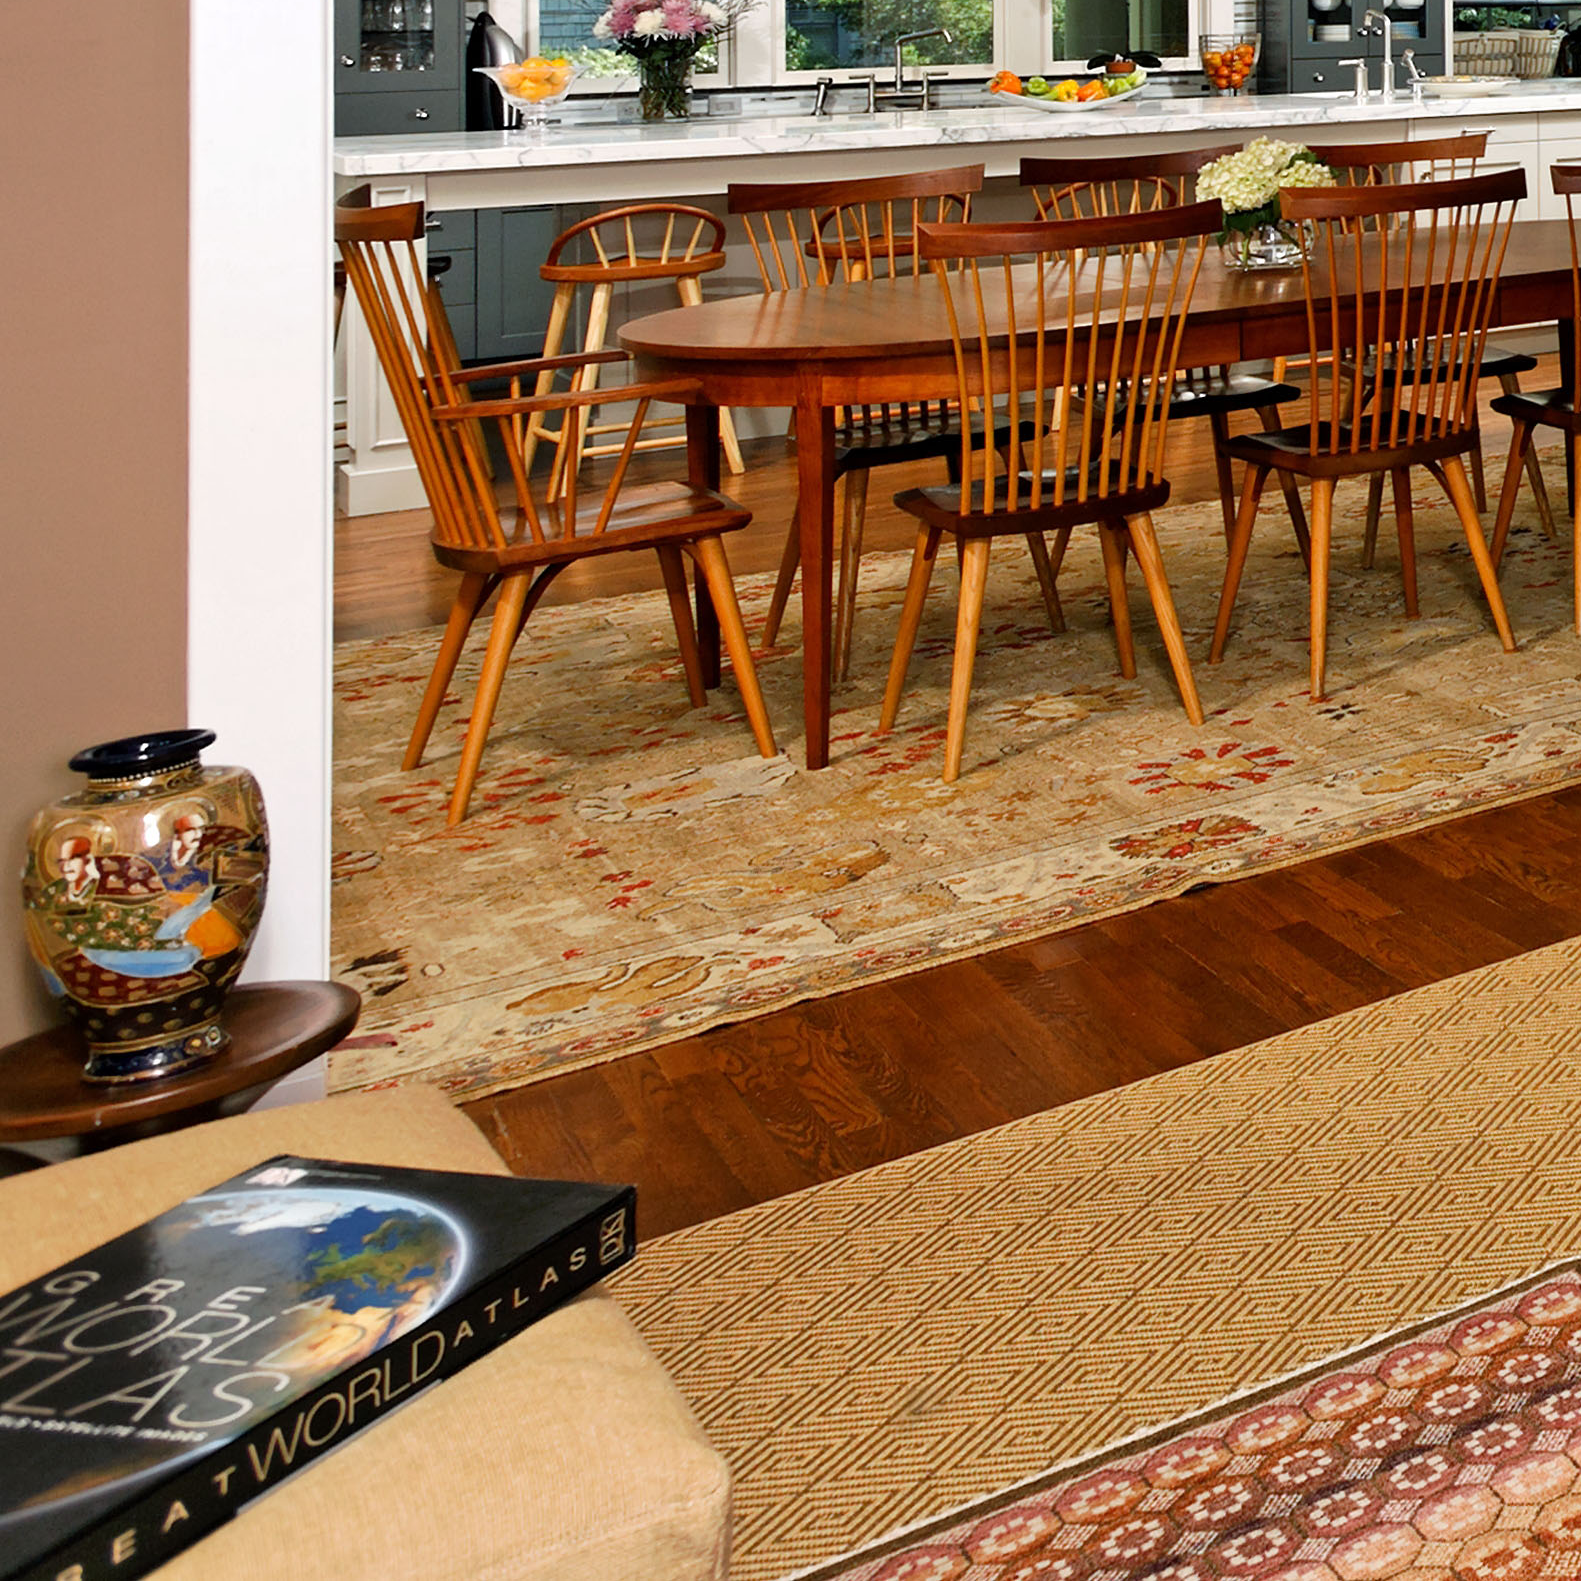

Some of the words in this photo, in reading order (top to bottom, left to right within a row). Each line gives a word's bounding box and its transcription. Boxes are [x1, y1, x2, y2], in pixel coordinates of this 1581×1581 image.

[0, 1348, 291, 1428] TLAS
[247, 1329, 445, 1482] WORLD
[453, 1246, 587, 1348] ATLAS
